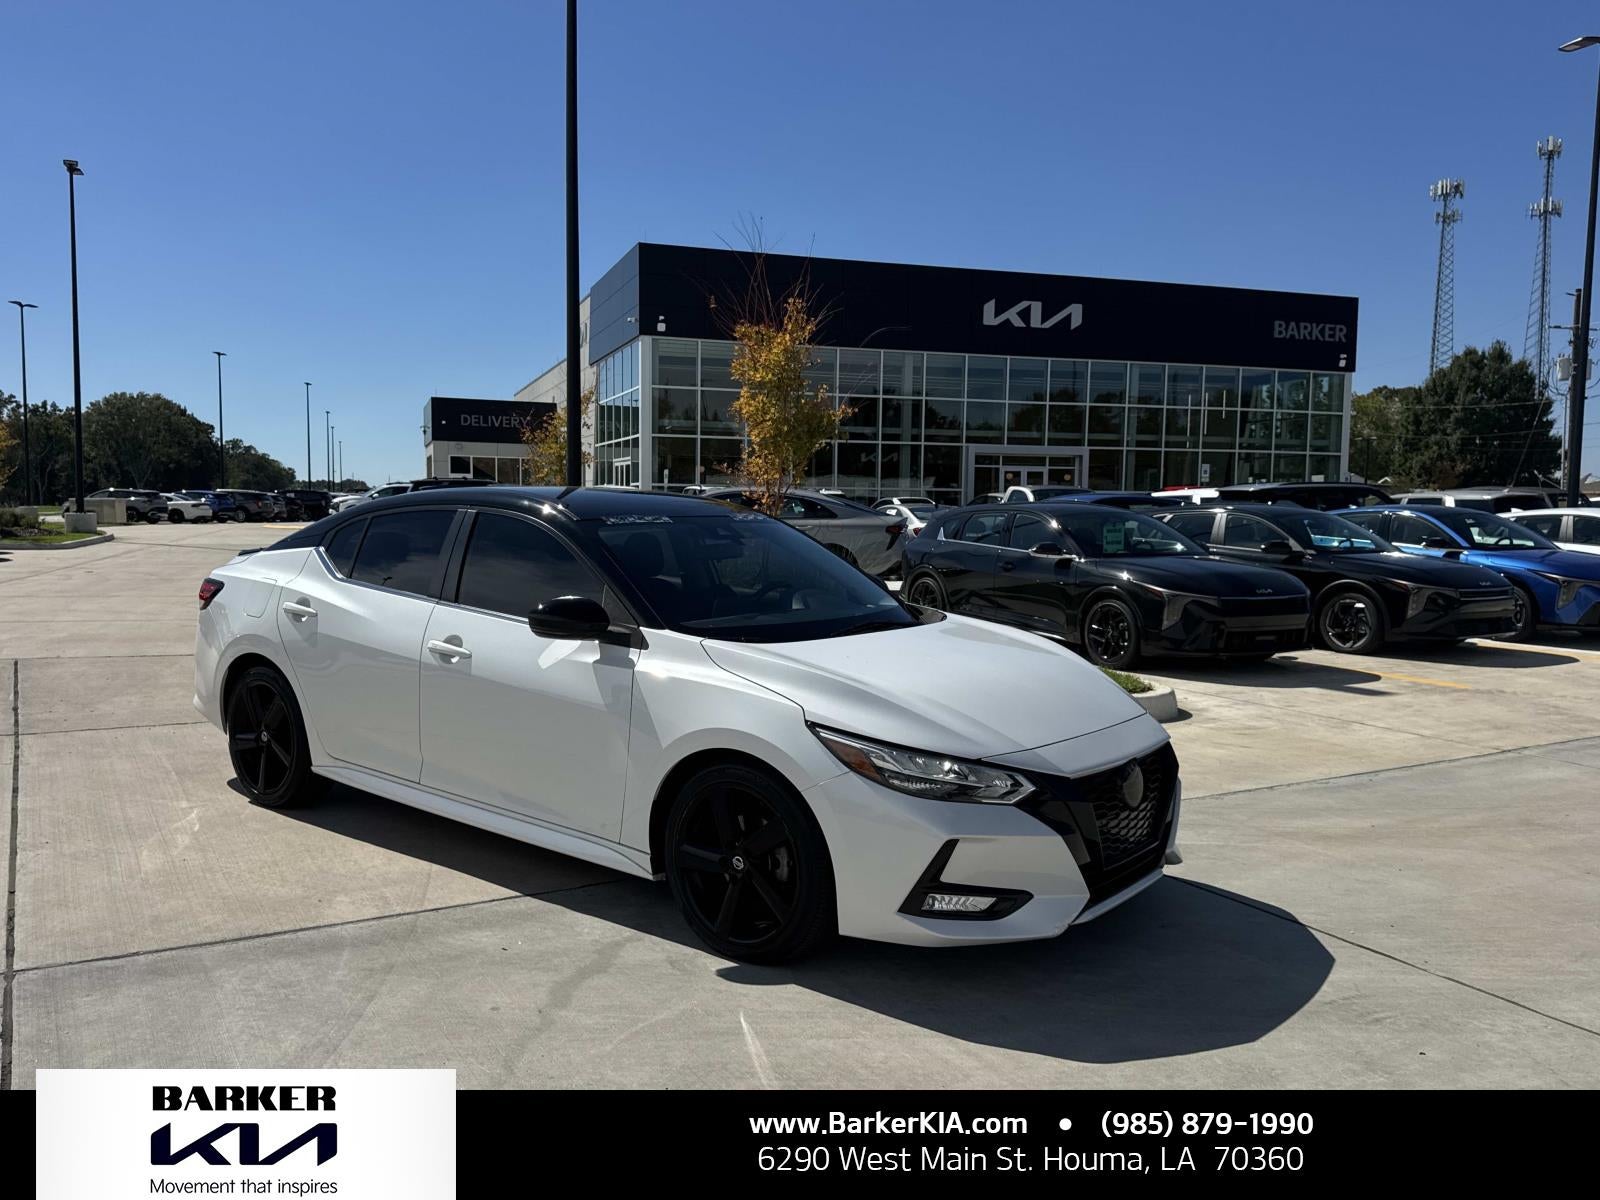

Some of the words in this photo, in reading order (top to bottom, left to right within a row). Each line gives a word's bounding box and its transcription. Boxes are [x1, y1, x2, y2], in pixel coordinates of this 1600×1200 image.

[982, 298, 1083, 330] KIA
[1273, 320, 1347, 343] BARKER
[460, 413, 529, 429] DELIVERY
